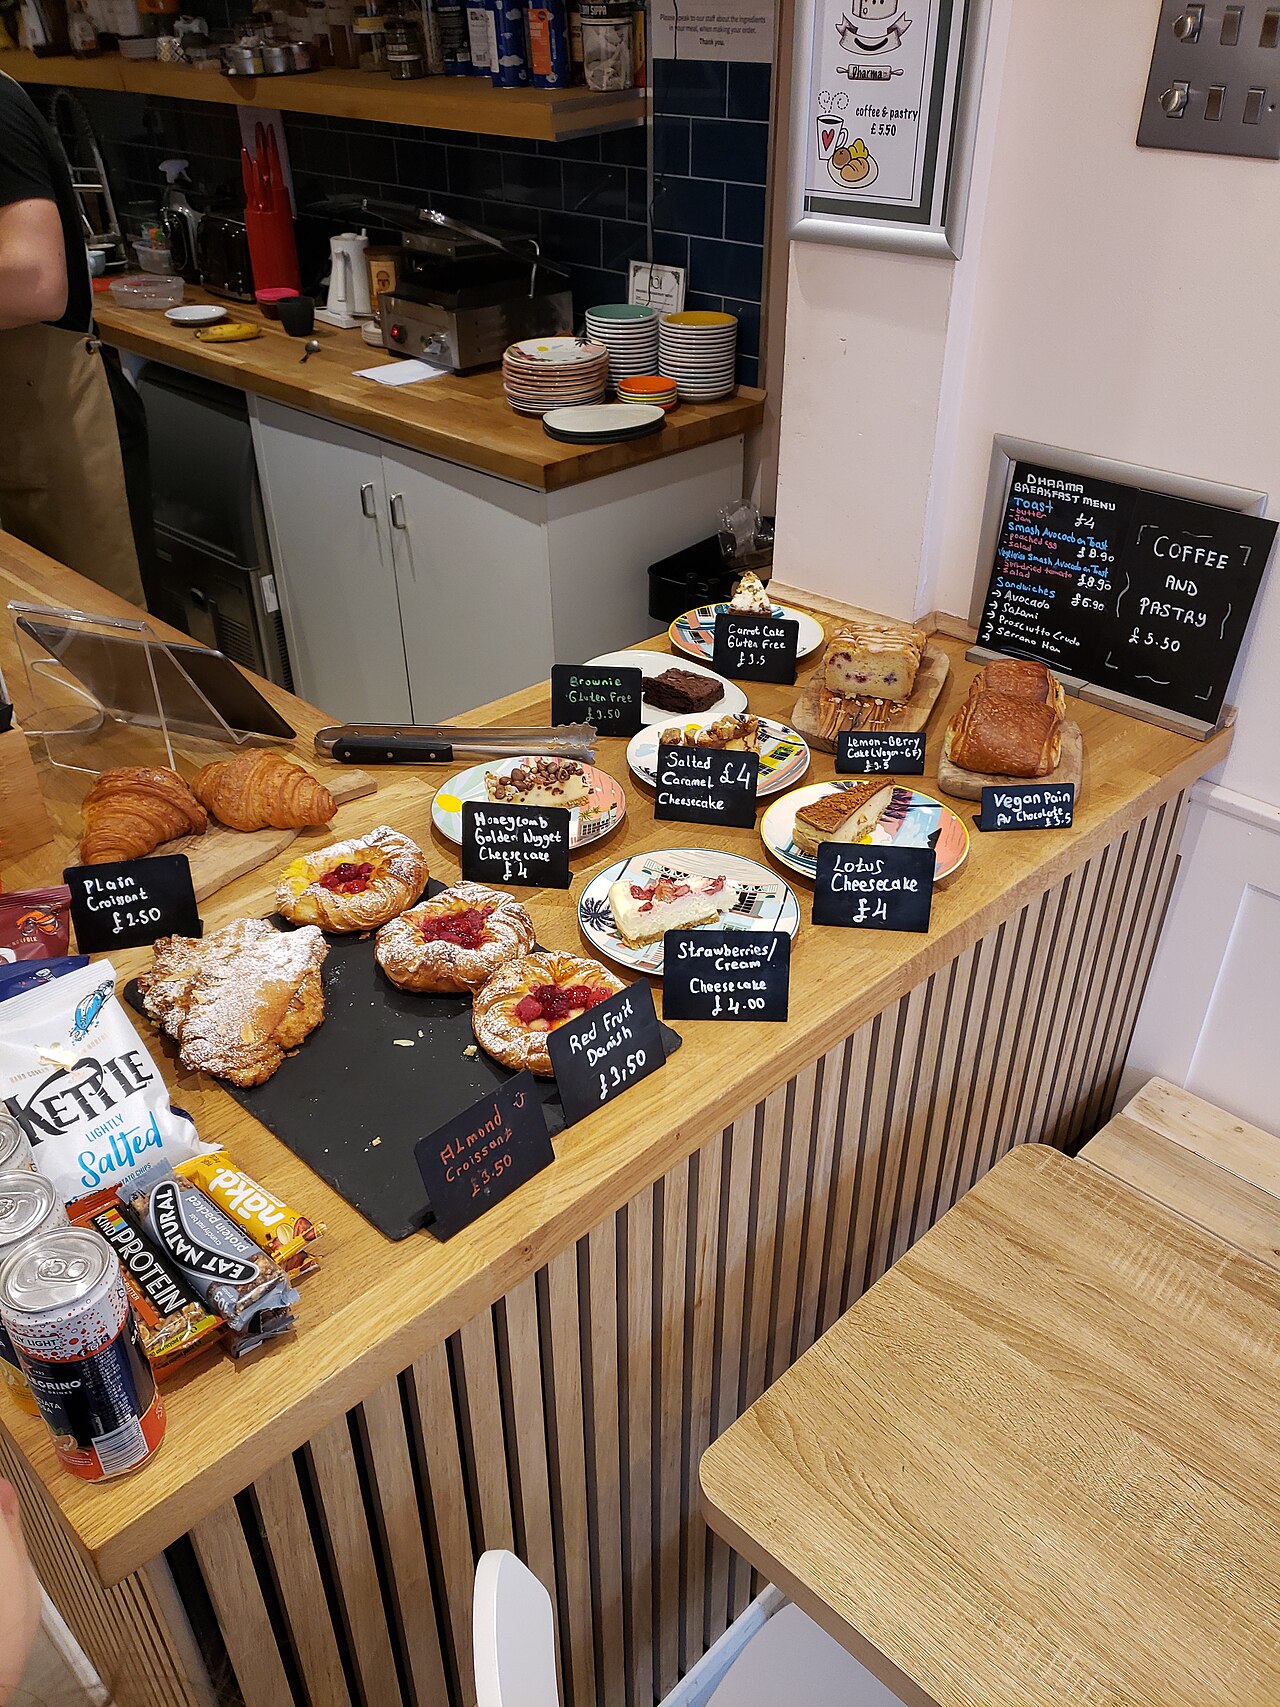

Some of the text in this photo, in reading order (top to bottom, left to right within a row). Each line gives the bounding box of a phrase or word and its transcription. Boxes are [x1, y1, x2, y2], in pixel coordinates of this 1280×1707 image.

[852, 66, 882, 78] Dharma
[856, 104, 918, 122] coffee & pastry
[1013, 497, 1054, 514] Toast
[1082, 496, 1116, 512] MENU
[1074, 513, 1095, 530] £4
[1008, 522, 1040, 536] Smash
[1076, 538, 1086, 546] on
[1086, 536, 1109, 551] Toast
[1008, 541, 1032, 552] salad
[1010, 532, 1058, 550] poached egg
[1028, 554, 1052, 566] Smash
[1054, 558, 1082, 572] Avocado
[1154, 536, 1229, 570] COFFEE
[1002, 568, 1030, 579] salad
[1044, 567, 1073, 579] tomato
[1076, 574, 1112, 592] £8.90
[996, 576, 1056, 599] Sandwiches
[1165, 574, 1198, 596] AND
[1004, 590, 1050, 610] Avocado
[1002, 602, 1039, 620] Salami
[1140, 596, 1207, 628] PASTRY
[728, 623, 785, 637] Carrot Cake
[996, 626, 1061, 654] Serrano Ham
[998, 614, 1081, 647] Prosciutto Crudo
[728, 634, 786, 650] Gluten Free
[569, 676, 622, 687] Brownie
[568, 690, 633, 704] Gluten Free
[666, 752, 712, 770] Salted
[661, 772, 714, 789] Caramel
[719, 762, 752, 790] £4
[658, 792, 725, 811] Cheesecake
[993, 790, 1071, 812] Vegan Pain
[474, 811, 548, 832] Honeycomb
[1016, 806, 1064, 822] Chocolate
[1044, 812, 1072, 828] £3.5
[474, 824, 562, 849] Golden Nugget
[502, 862, 528, 882] £4
[833, 854, 884, 875] Lotus
[830, 872, 919, 893] Cheesecake
[86, 888, 149, 912] Croissant
[112, 907, 162, 934] £2.50
[852, 898, 888, 924] £4
[714, 958, 761, 972] Cream
[690, 978, 768, 994] Cheesecake
[712, 995, 765, 1016] £4.00
[570, 998, 634, 1055] Red Fruit
[586, 1025, 632, 1068] Danish
[4, 1050, 154, 1148] KETTLE
[85, 1114, 125, 1142] LIGHTLY
[78, 1111, 163, 1188] Salted
[445, 1127, 513, 1183] Croissant
[136, 1162, 152, 1178] CHIPS
[470, 1154, 512, 1198] £3.50
[94, 1214, 116, 1237] KIND
[156, 1188, 205, 1266] NATURAL
[184, 1196, 250, 1252] protein packed
[110, 1227, 187, 1314] PROTEIN
[202, 1256, 246, 1280] EAT
[28, 1339, 57, 1347] LIGHT
